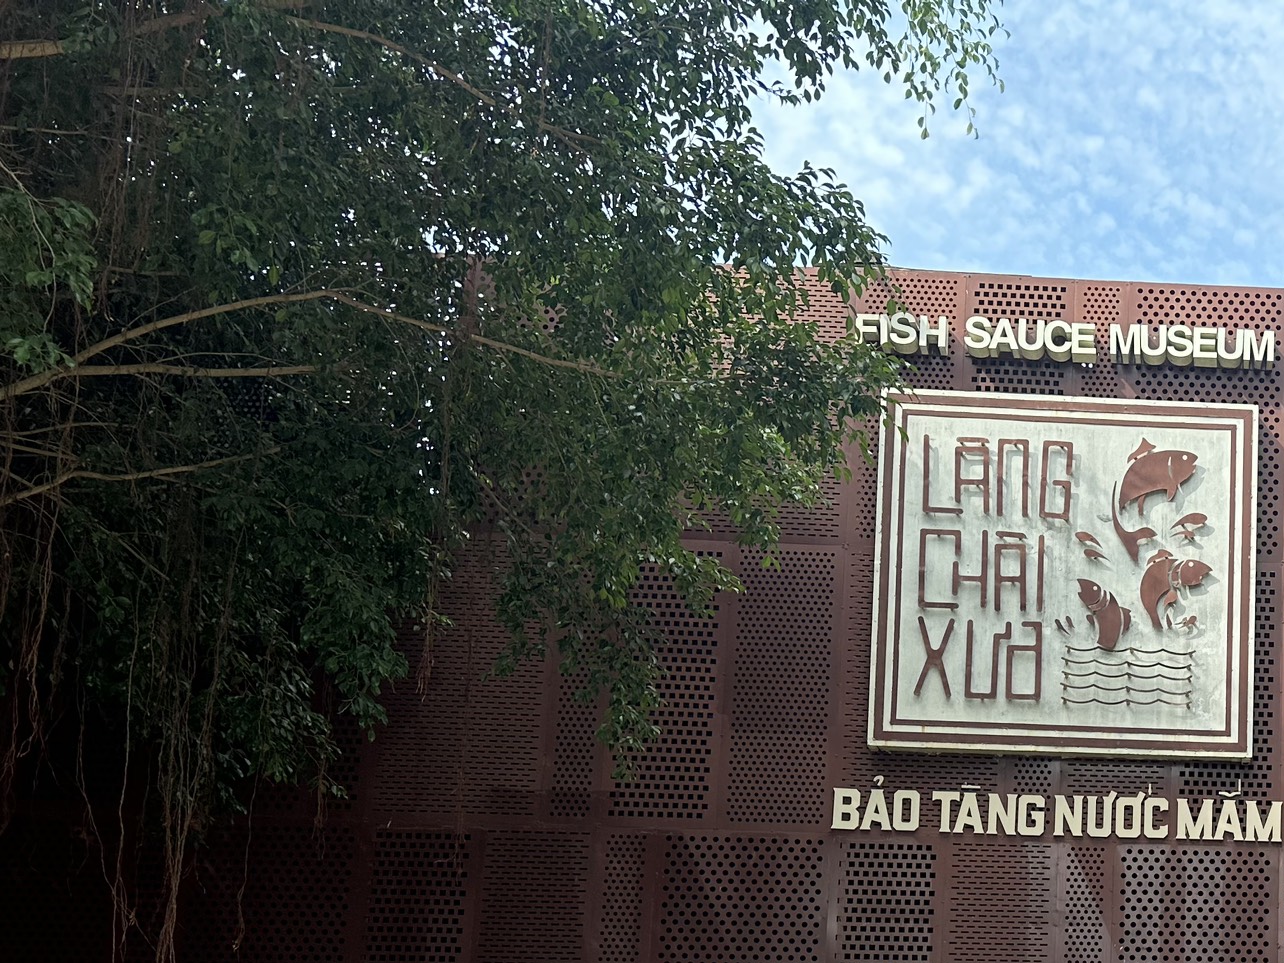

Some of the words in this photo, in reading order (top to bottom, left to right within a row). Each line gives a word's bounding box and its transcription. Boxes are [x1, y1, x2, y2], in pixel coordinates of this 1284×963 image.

[854, 312, 947, 352] FISH
[964, 315, 1096, 358] SAUCE
[1110, 323, 1275, 364] MUSEUM
[831, 775, 921, 831] BẢO
